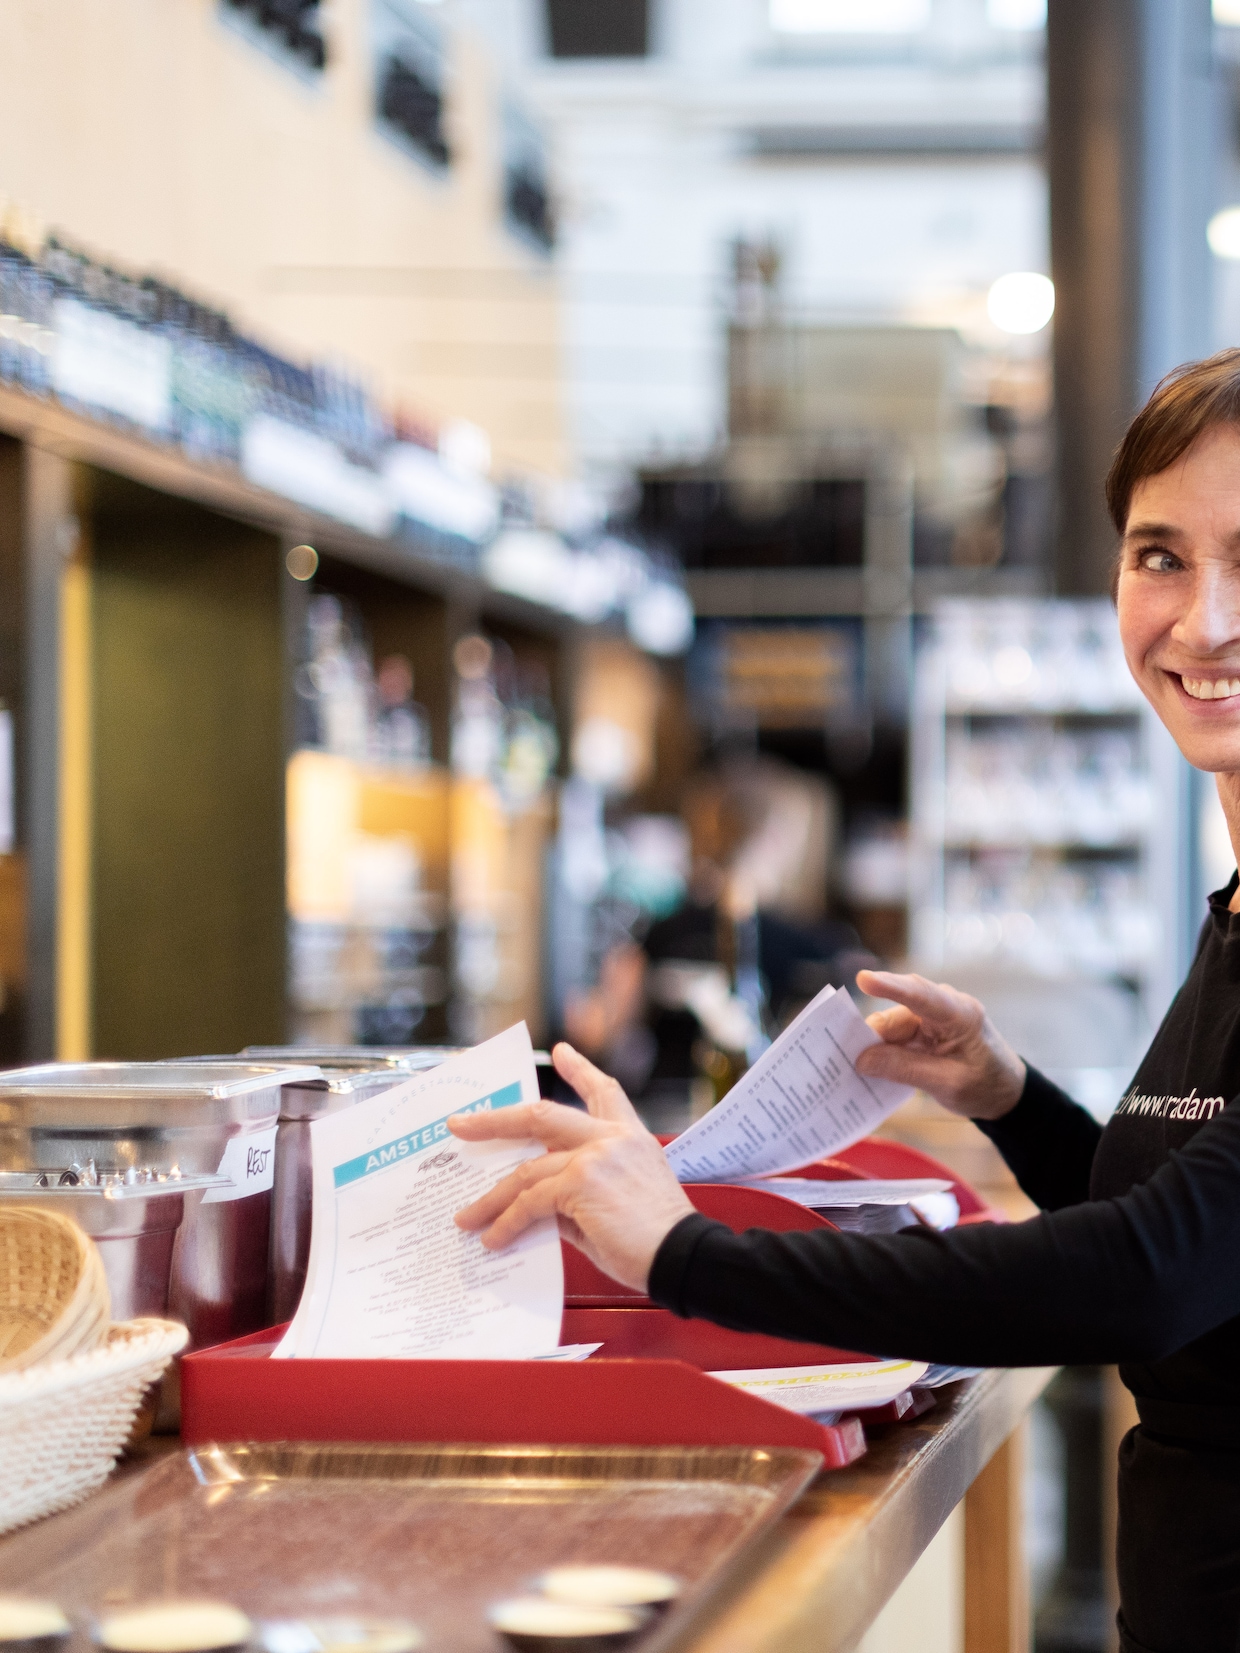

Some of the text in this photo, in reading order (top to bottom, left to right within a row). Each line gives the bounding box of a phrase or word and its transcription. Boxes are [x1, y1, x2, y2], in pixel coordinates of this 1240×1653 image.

[364, 1098, 492, 1172] AMSTERAM
[246, 1146, 271, 1179] REST
[414, 1162, 462, 1188] FRUITS DE MER
